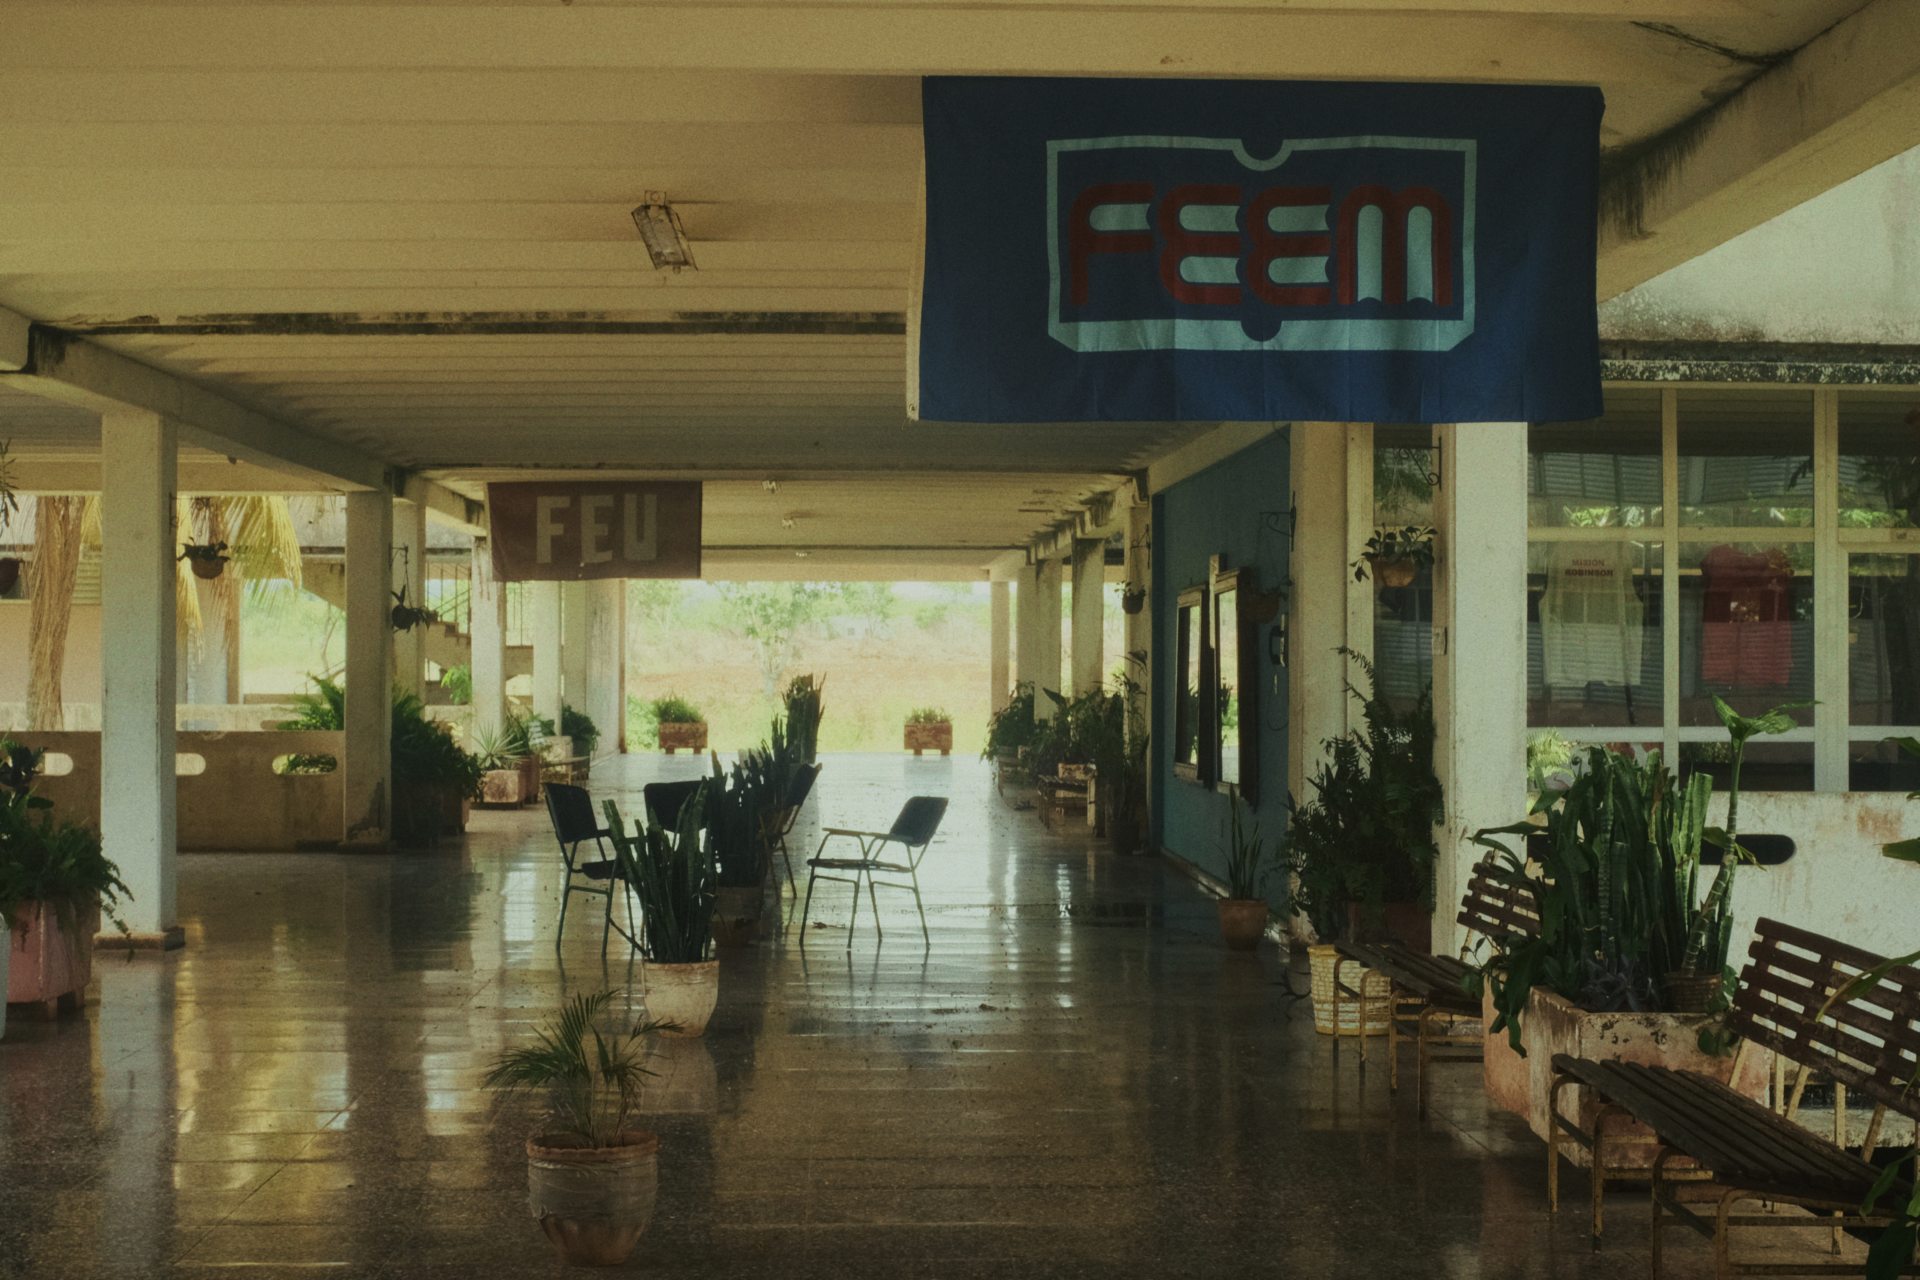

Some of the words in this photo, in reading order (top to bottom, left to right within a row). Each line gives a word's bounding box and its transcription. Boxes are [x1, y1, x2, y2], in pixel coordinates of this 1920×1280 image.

[1069, 183, 1452, 307] FEEM
[536, 493, 657, 563] FEU
[1564, 568, 1614, 577] ROBINSON
